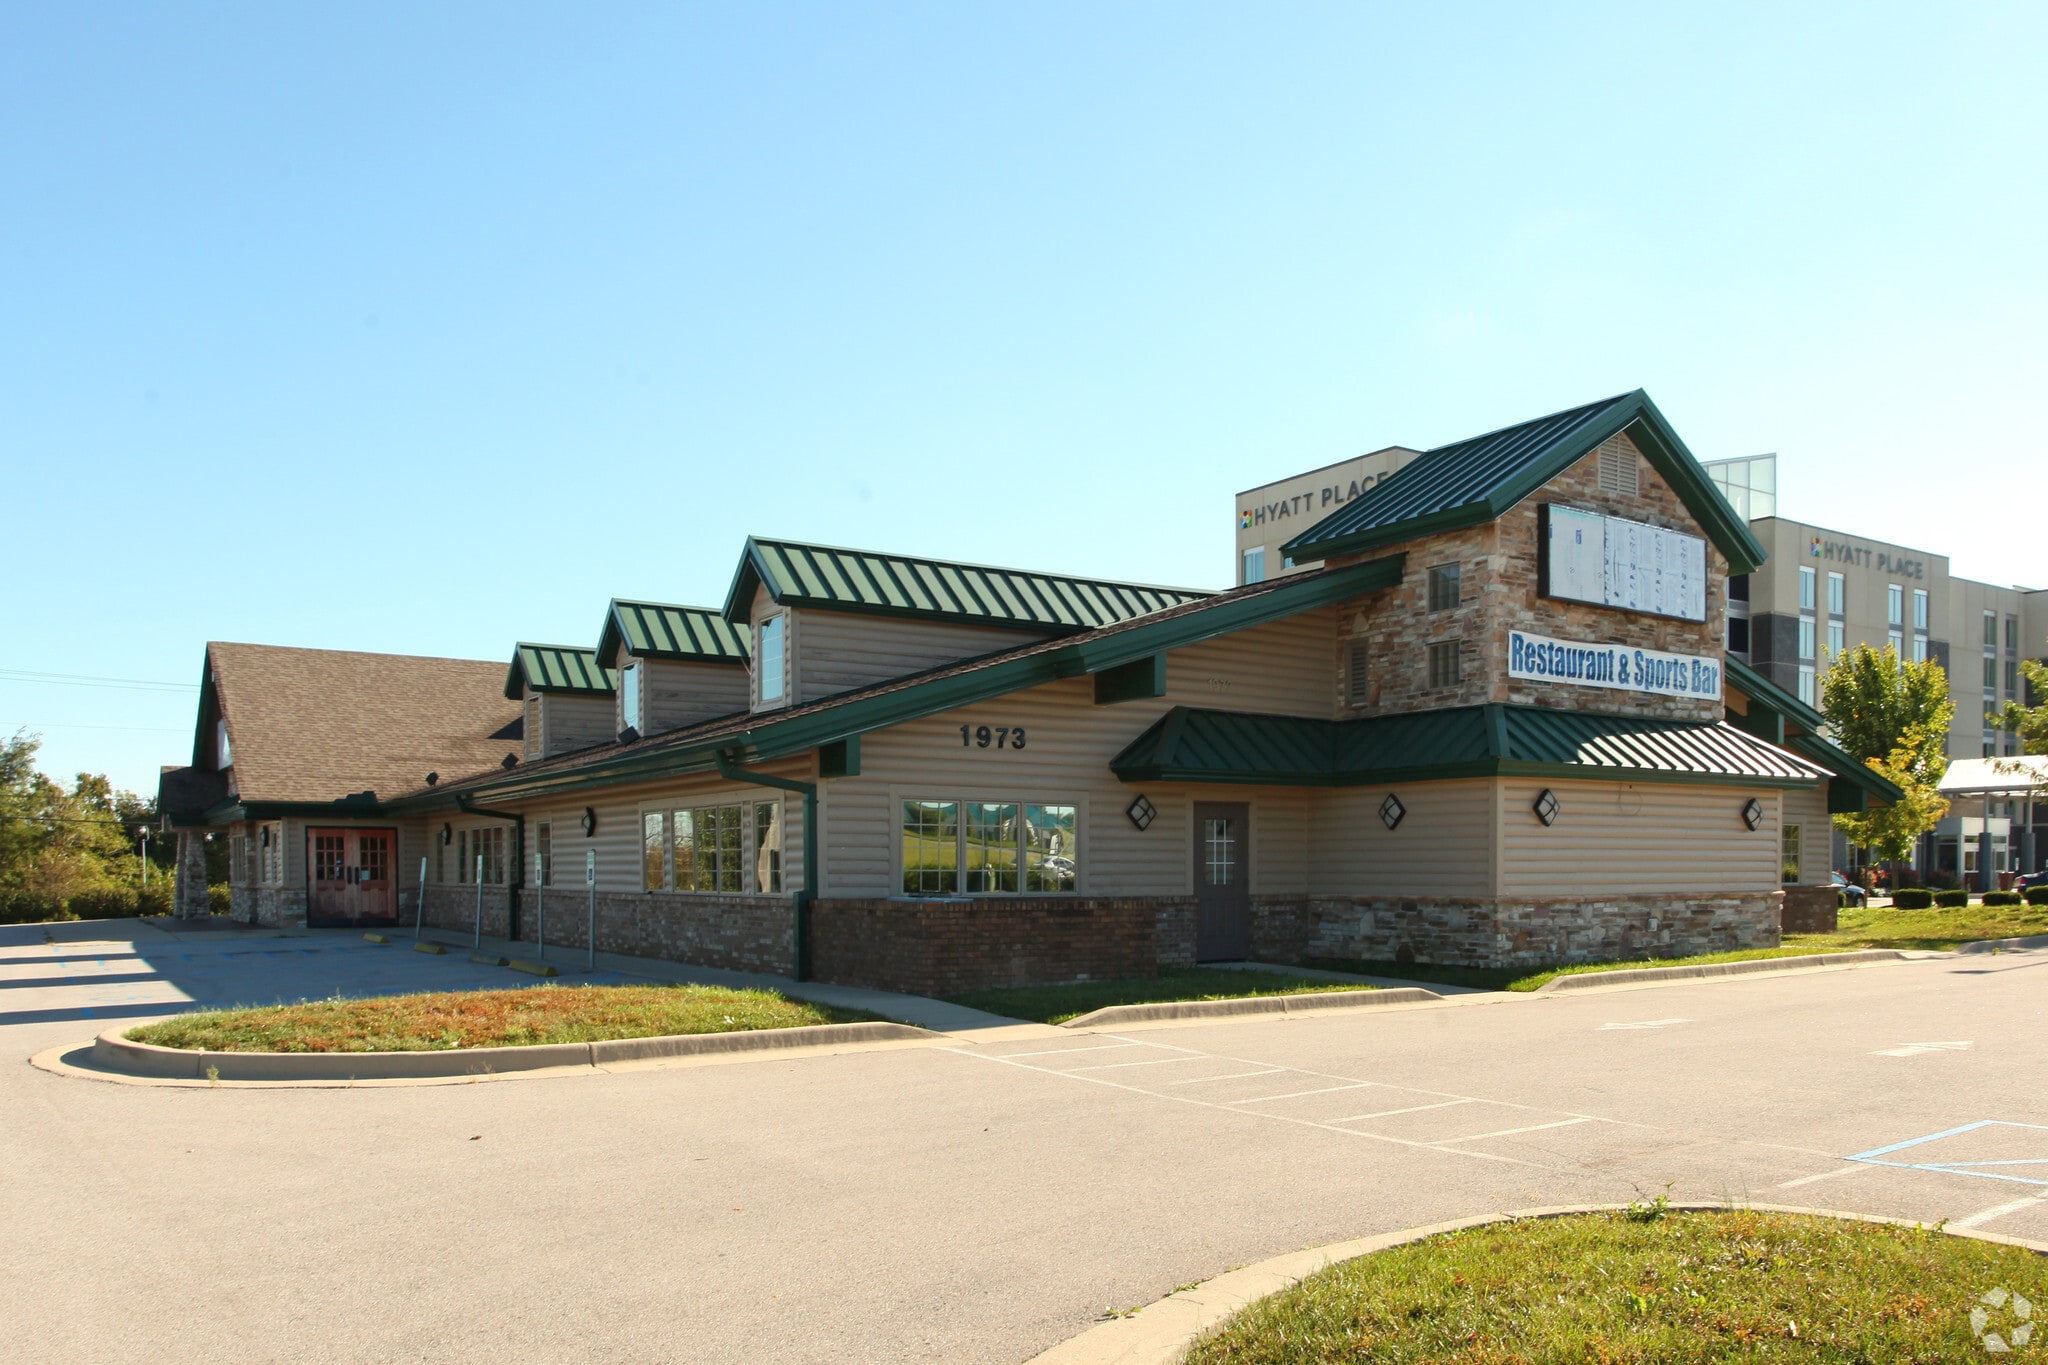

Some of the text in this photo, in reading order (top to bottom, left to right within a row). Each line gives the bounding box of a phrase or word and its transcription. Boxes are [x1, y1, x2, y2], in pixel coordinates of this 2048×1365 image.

[1254, 492, 1314, 526] HYATT
[1824, 541, 1923, 579] HYATT PLACE
[1511, 633, 1718, 694] Restaurant & Sports Bar
[960, 724, 1026, 749] 1973
